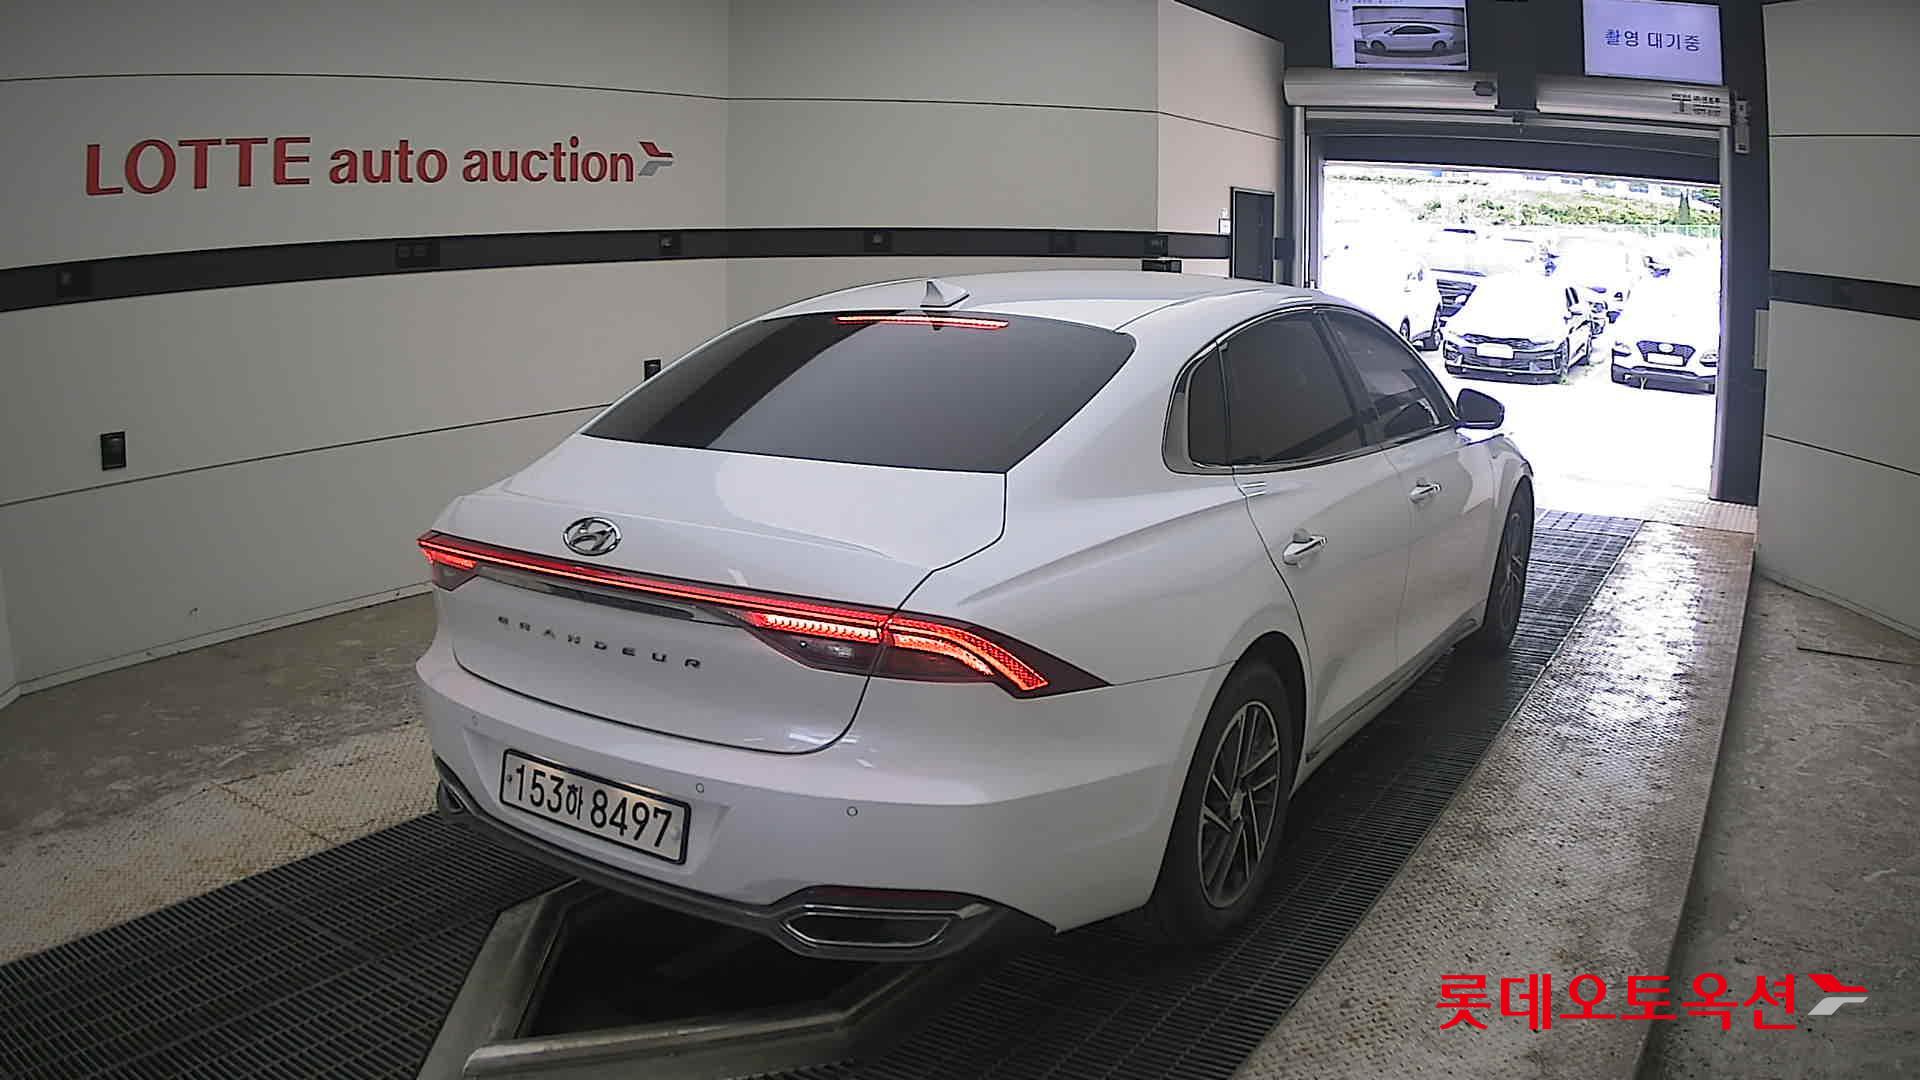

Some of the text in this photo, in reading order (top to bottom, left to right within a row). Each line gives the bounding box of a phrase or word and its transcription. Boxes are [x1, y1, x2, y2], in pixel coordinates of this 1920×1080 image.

[1647, 31, 1701, 51] 대기중
[85, 135, 635, 196] LOTTE auto auction
